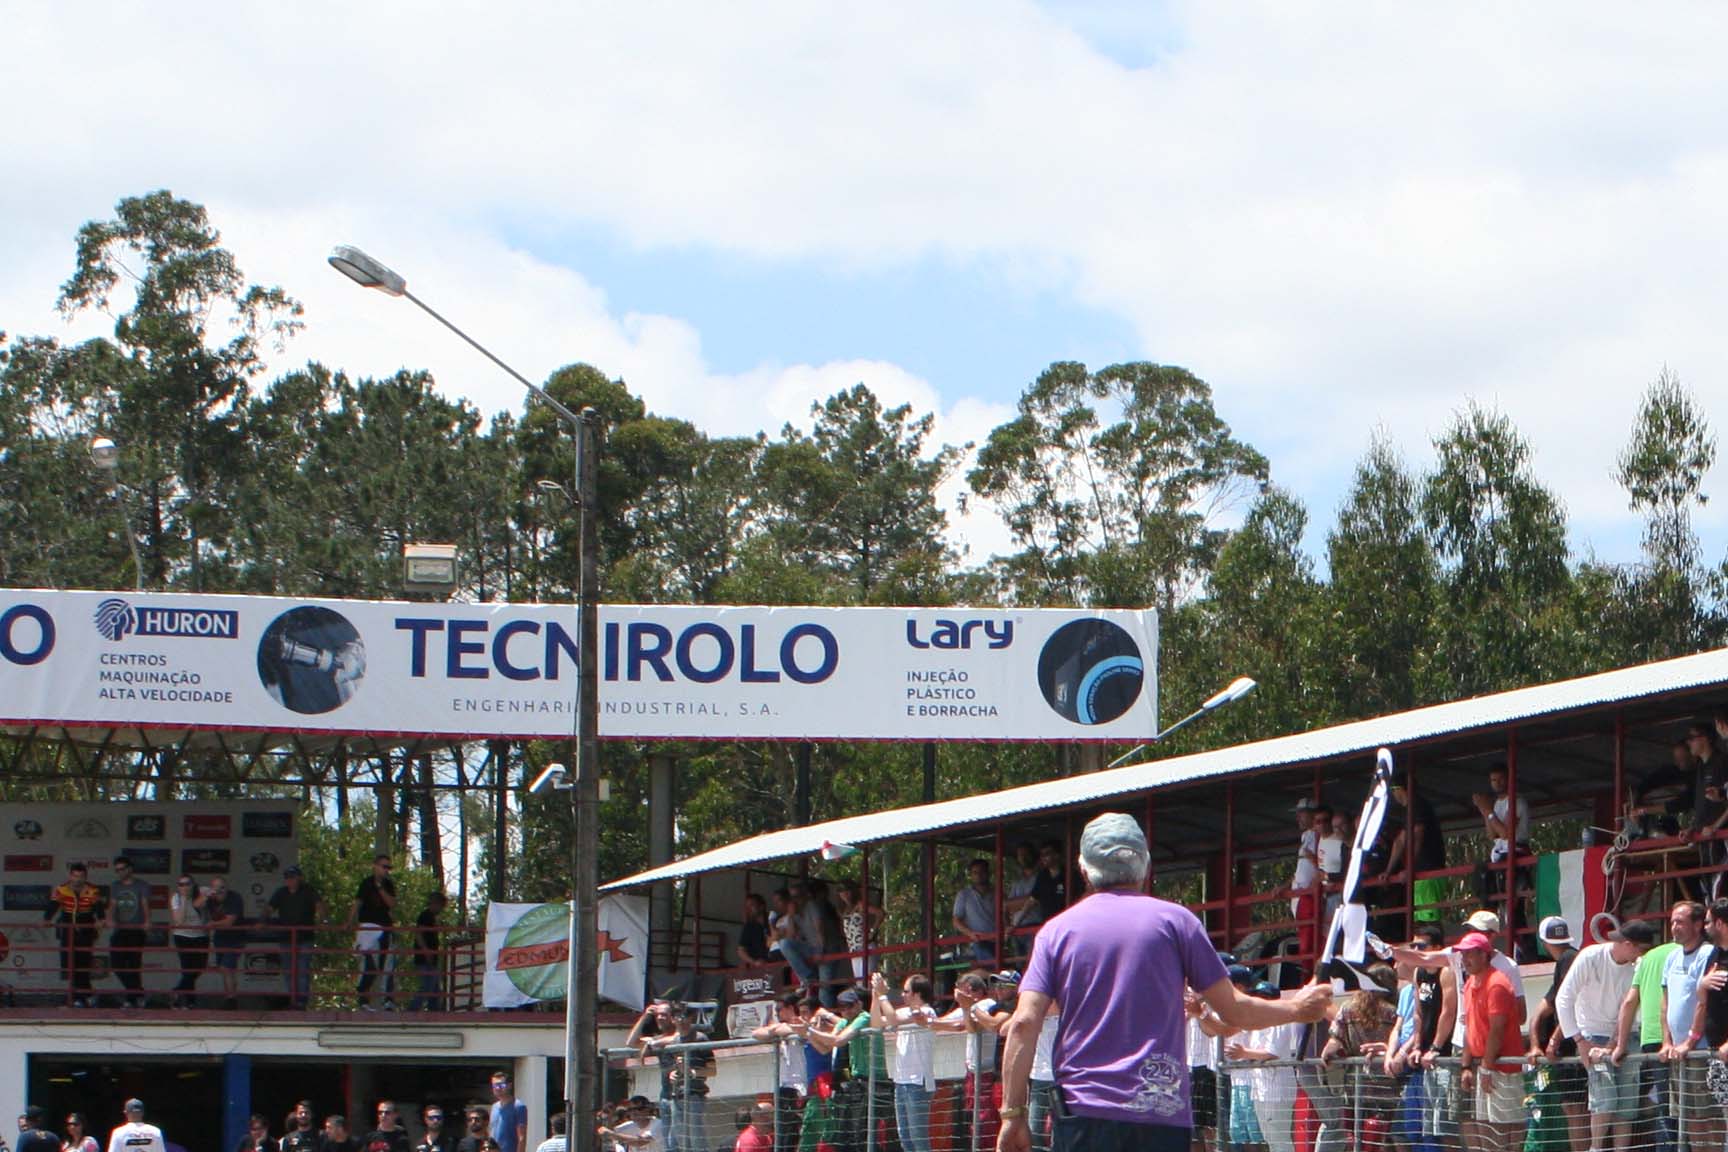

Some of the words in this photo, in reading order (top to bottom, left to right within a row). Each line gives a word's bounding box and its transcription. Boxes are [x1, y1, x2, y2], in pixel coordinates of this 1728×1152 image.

[145, 609, 231, 638] HURON
[100, 653, 168, 668] CENTROS
[394, 617, 840, 685] TECNIROLO
[99, 669, 202, 688] MAQUINAÇÃO
[906, 668, 969, 687] INJEÇÃO
[99, 688, 138, 702] ALTA
[140, 688, 233, 704] VELOCIDADE
[906, 685, 977, 701] PLÁSTICO
[452, 698, 578, 714] ENGENHARI
[739, 702, 780, 717] S.A.
[906, 704, 915, 718] E
[918, 704, 999, 718] BORRACHA
